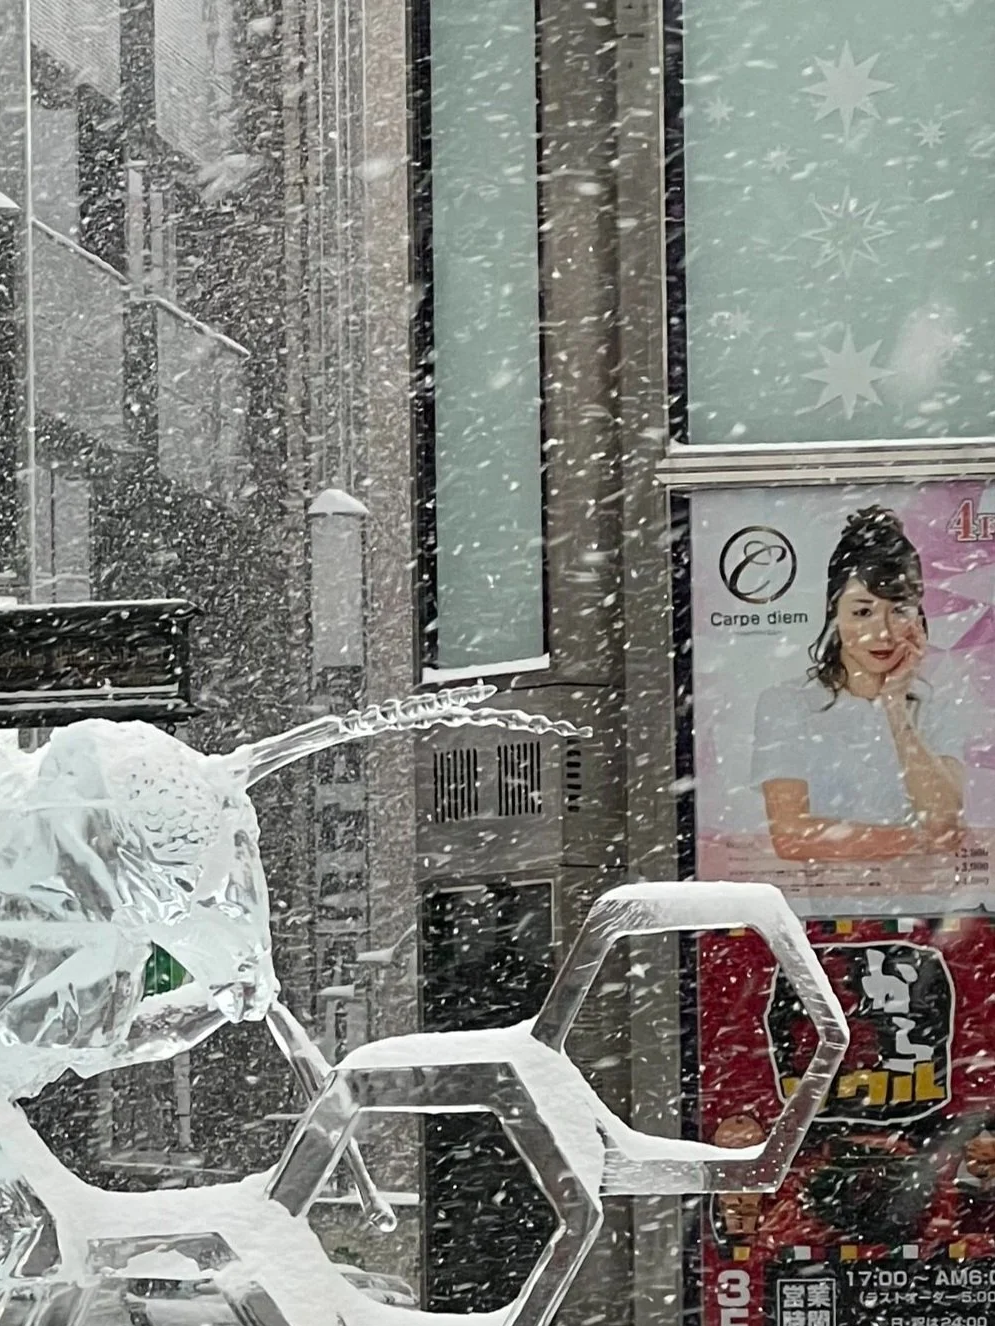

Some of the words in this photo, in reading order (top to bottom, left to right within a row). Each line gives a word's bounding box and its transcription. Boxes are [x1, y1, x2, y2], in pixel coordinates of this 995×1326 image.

[710, 611, 760, 626] Carpe
[767, 610, 809, 625] diem
[846, 1270, 908, 1287] 17:00
[782, 1284, 831, 1308] 営業
